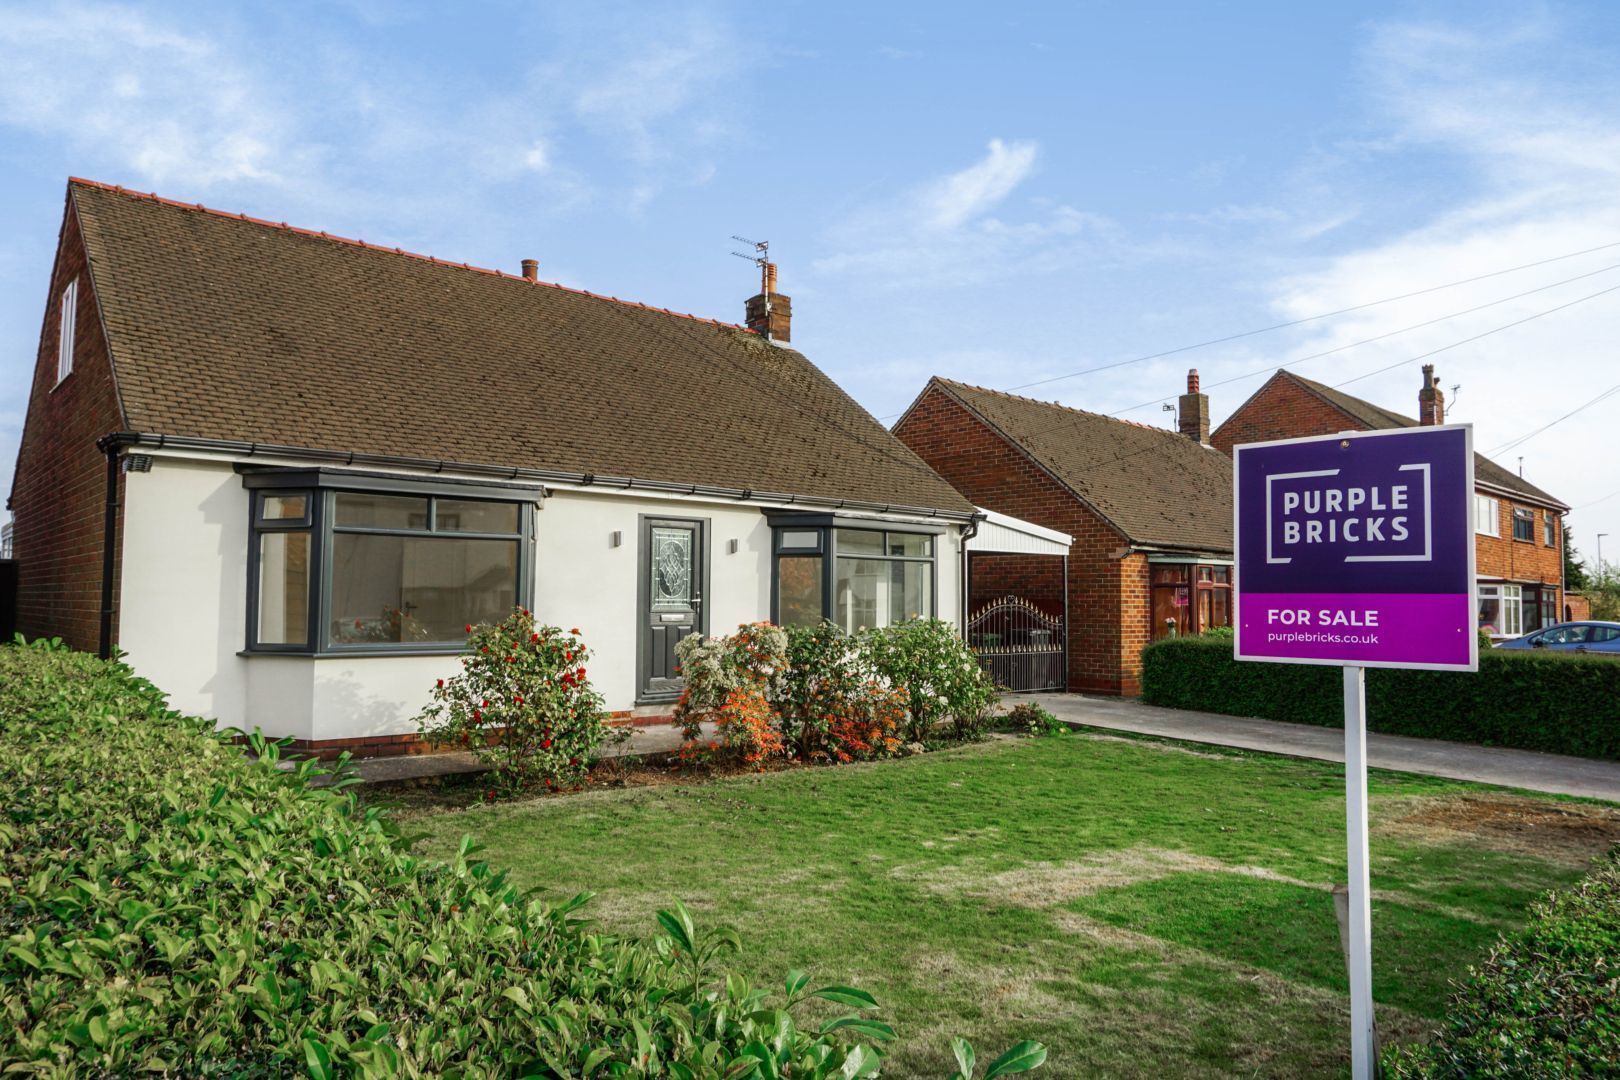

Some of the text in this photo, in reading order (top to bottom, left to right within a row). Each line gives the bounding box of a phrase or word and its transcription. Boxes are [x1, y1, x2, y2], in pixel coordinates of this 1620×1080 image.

[1284, 485, 1408, 515] PURPLE
[1284, 516, 1409, 544] BRICKS
[1268, 609, 1379, 627] FOR SALE
[1268, 632, 1379, 644] purplebricks.co.uk
